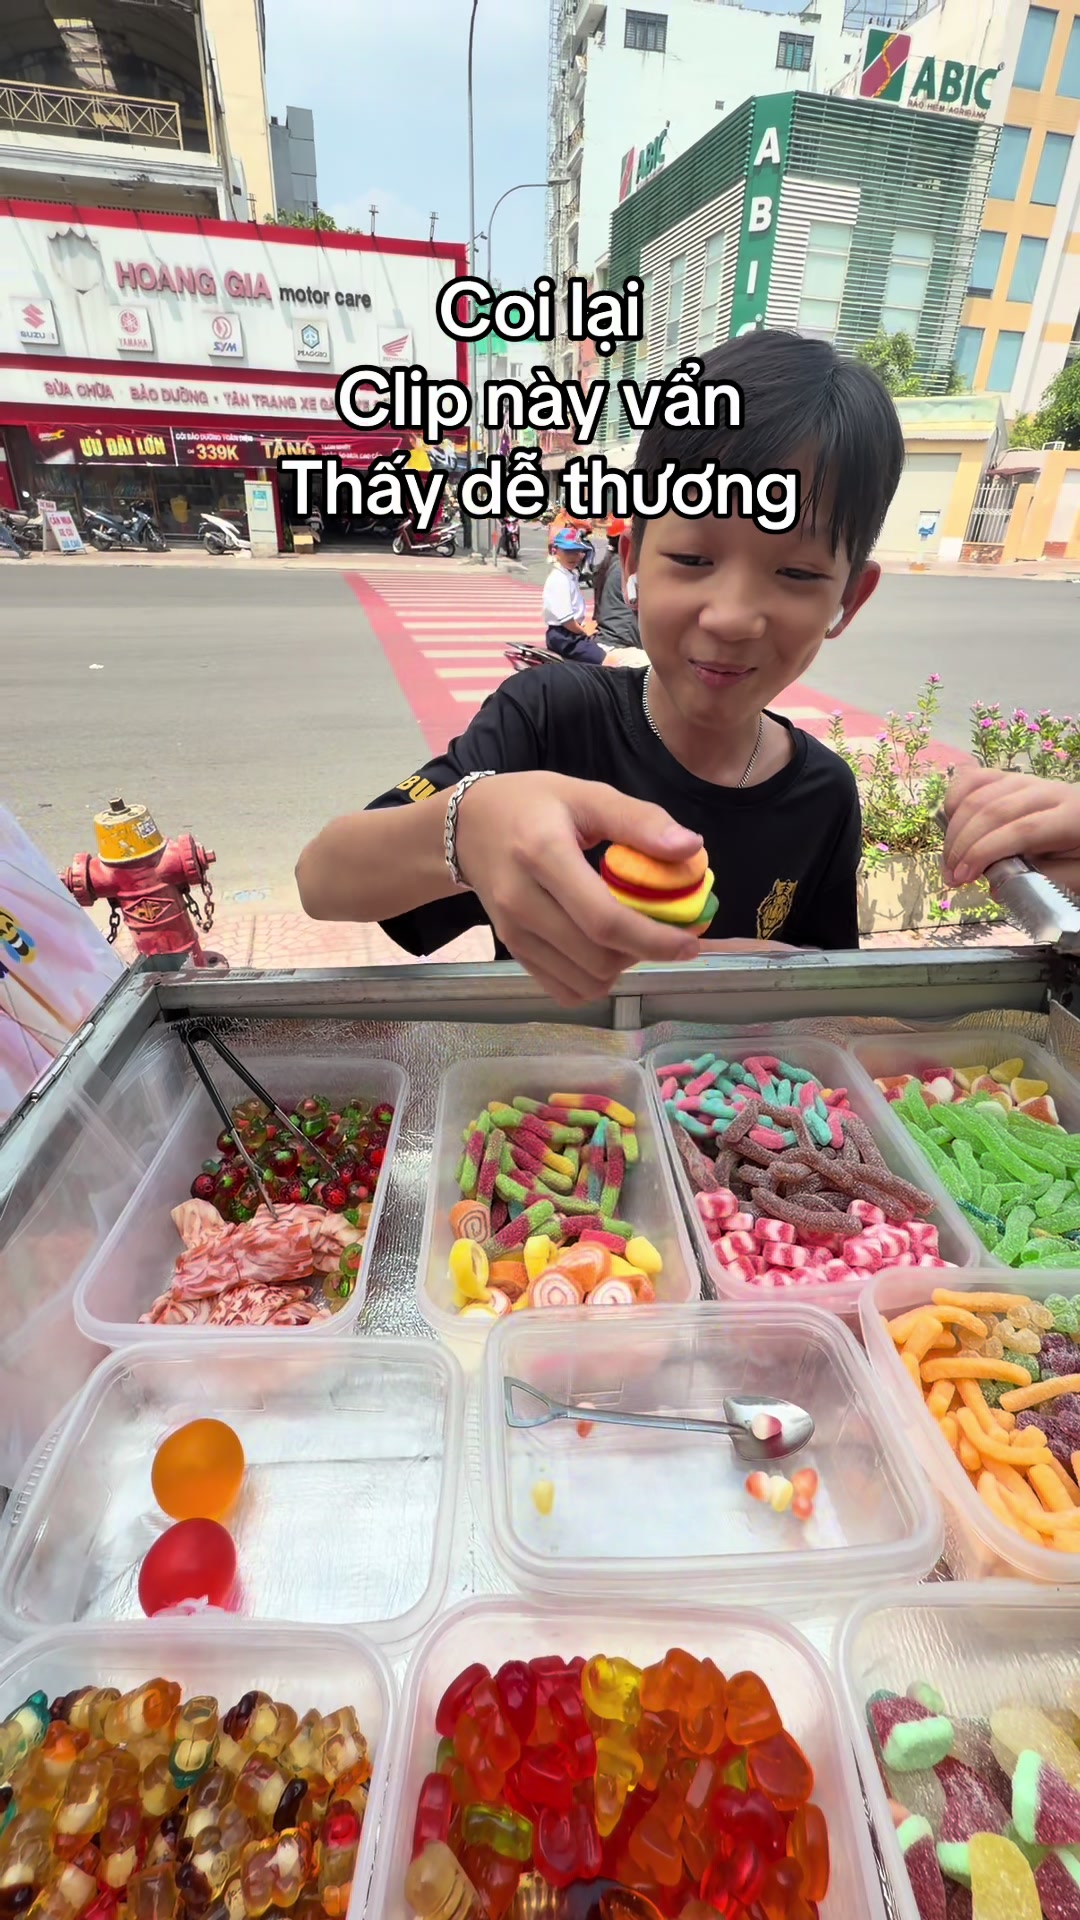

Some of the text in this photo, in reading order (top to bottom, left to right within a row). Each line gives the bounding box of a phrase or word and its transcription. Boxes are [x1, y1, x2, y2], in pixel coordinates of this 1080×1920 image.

[910, 56, 999, 110] ABIC
[949, 107, 987, 119] AGRIBANK
[224, 270, 273, 302] GIA
[279, 286, 331, 305] motor
[335, 291, 372, 308] care
[118, 337, 149, 348] YAMAHA
[213, 341, 237, 353] SYM
[252, 394, 296, 410] TRANG
[300, 398, 318, 411] XE
[136, 434, 167, 456] LỚN
[195, 443, 239, 460] 339K
